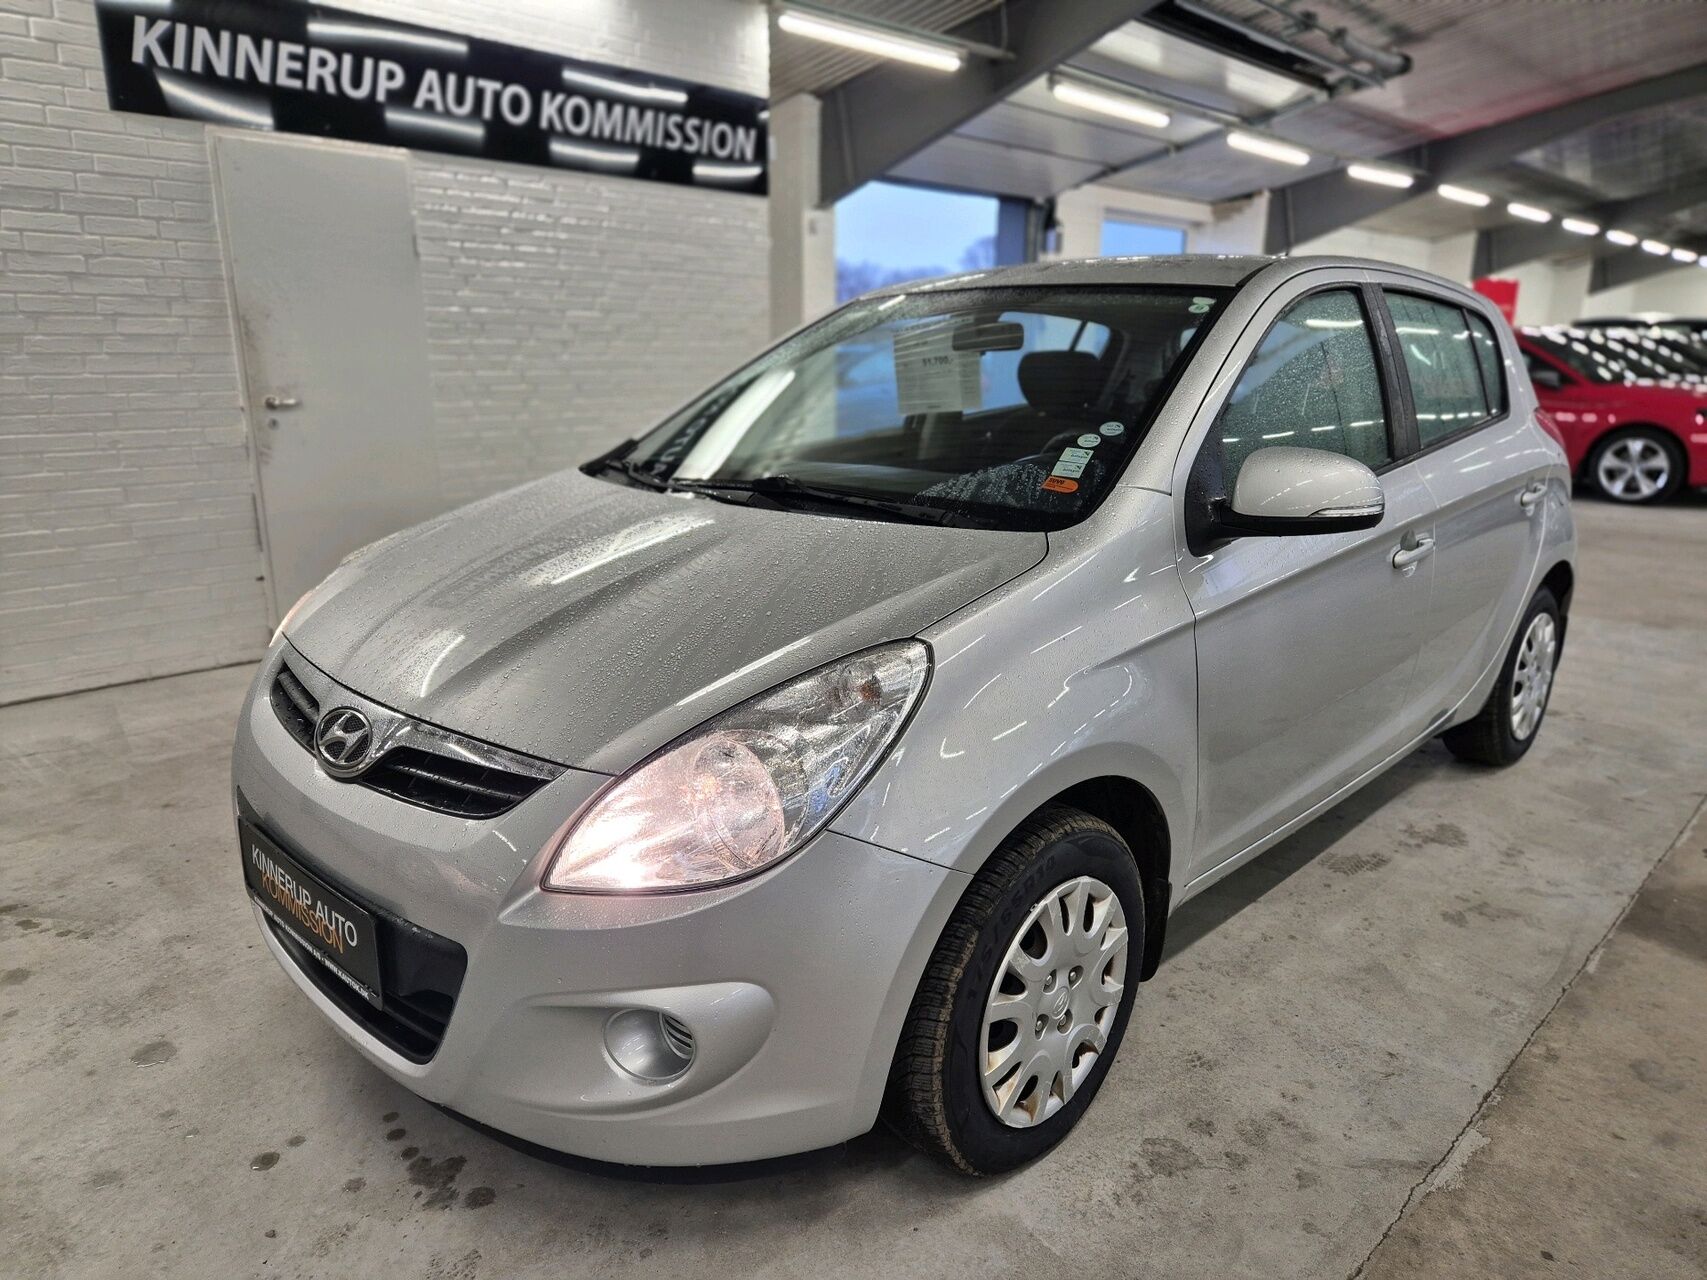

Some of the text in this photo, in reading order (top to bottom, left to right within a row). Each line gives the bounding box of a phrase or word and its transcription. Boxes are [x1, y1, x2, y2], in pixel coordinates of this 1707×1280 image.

[132, 15, 757, 161] KINNERUP AUTO KOMMISSION
[251, 844, 358, 947] KINNERUP AUTO
[261, 871, 345, 954] KOMMISSION
